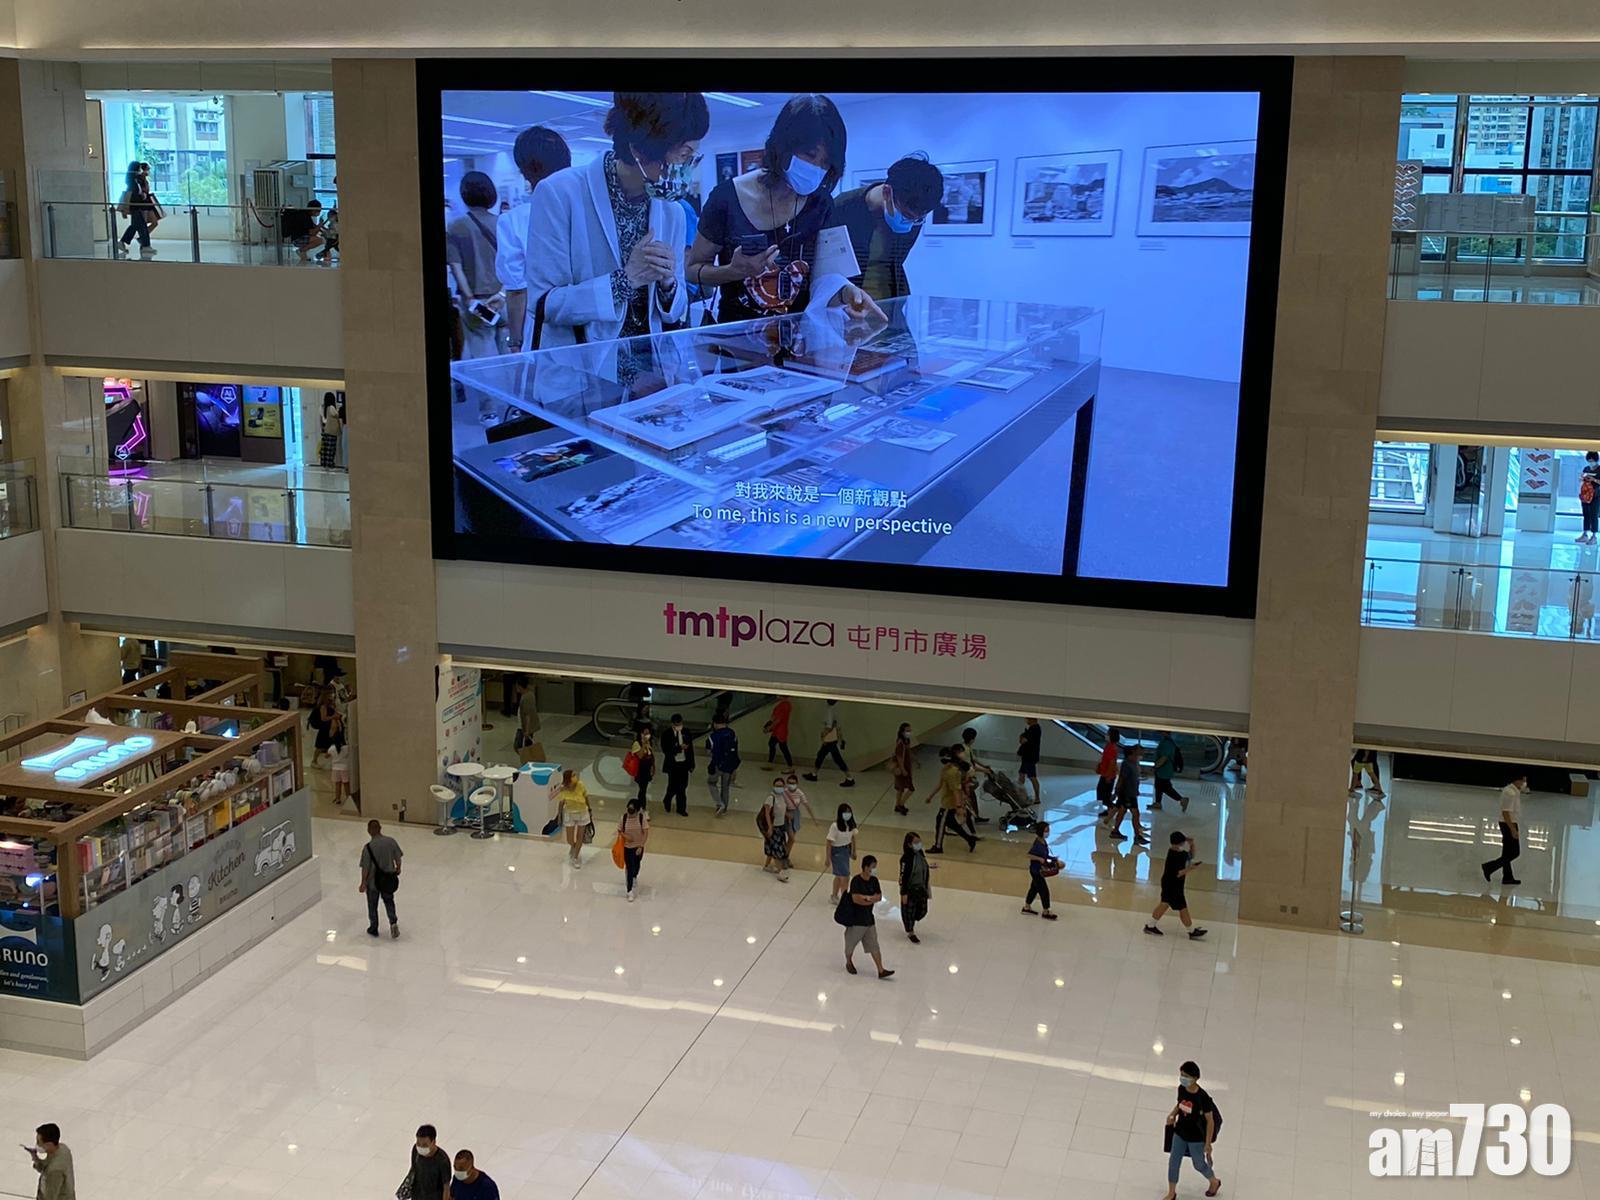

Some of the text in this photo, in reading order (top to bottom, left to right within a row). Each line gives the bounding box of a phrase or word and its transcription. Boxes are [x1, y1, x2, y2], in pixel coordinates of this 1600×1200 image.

[735, 481, 908, 509] 對我來說是一個新觀點
[692, 503, 953, 536] To me, this is a new perspective
[663, 601, 834, 648] tmtplaza
[847, 625, 988, 659] 屯門市廣場
[207, 851, 246, 889] Kitchen
